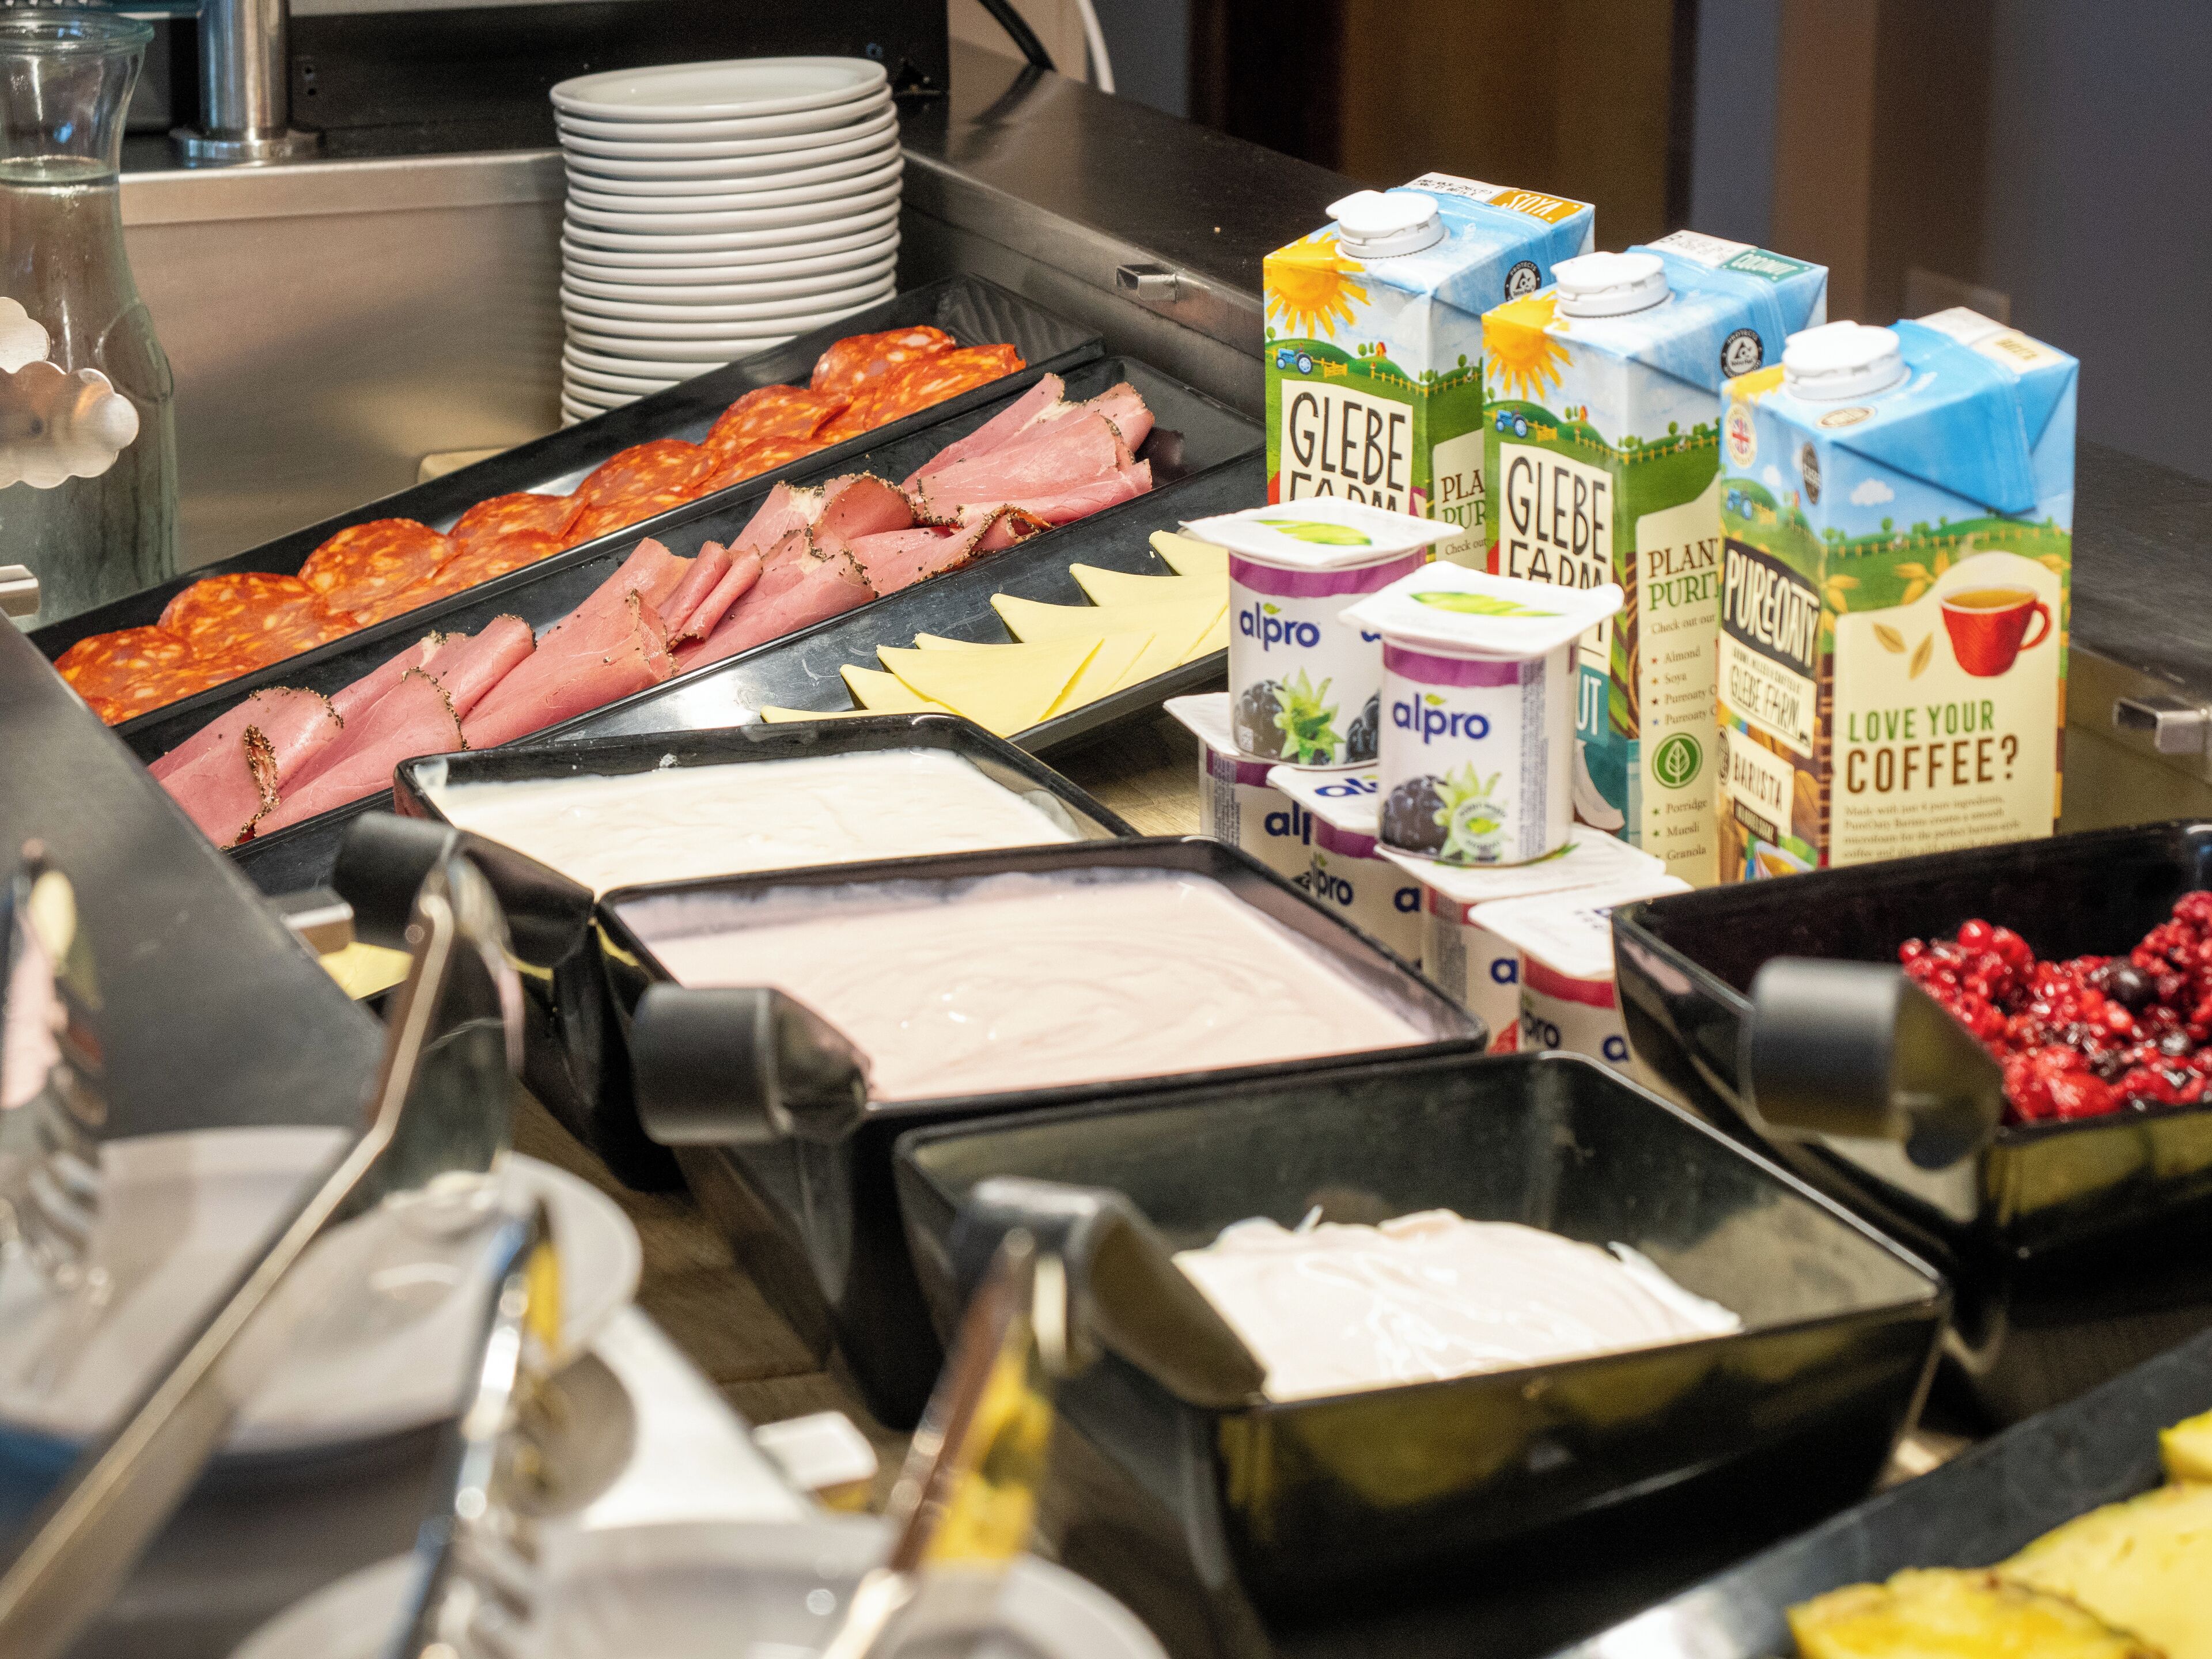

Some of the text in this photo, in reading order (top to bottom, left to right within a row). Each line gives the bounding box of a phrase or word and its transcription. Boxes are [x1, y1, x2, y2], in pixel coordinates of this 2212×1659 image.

[1508, 193, 1563, 216] SOYA
[1290, 392, 1406, 491] GLEBE
[1508, 456, 1607, 564] GLEBE
[1445, 540, 1471, 555] Check
[1648, 537, 1719, 578] PLAN
[1724, 548, 1820, 668] PUREOATY
[1240, 601, 1320, 652] alpro
[1651, 618, 1680, 634] Check
[1683, 615, 1697, 628] out
[1664, 646, 1701, 664] Almond
[1664, 671, 1687, 687] Soya
[1664, 689, 1706, 704] Pureoaty
[1730, 664, 1800, 737] GLEBE FARM
[1392, 692, 1490, 745] alpro
[1664, 710, 1706, 725] Pureoaty
[1849, 699, 1994, 742] LOVE YOUR
[1847, 733, 2020, 794] COFFEE?
[1734, 751, 1782, 811] BARISTA
[1665, 797, 1707, 814] Porridge
[1666, 821, 1700, 838] Muesli
[1666, 844, 1706, 860] Granola
